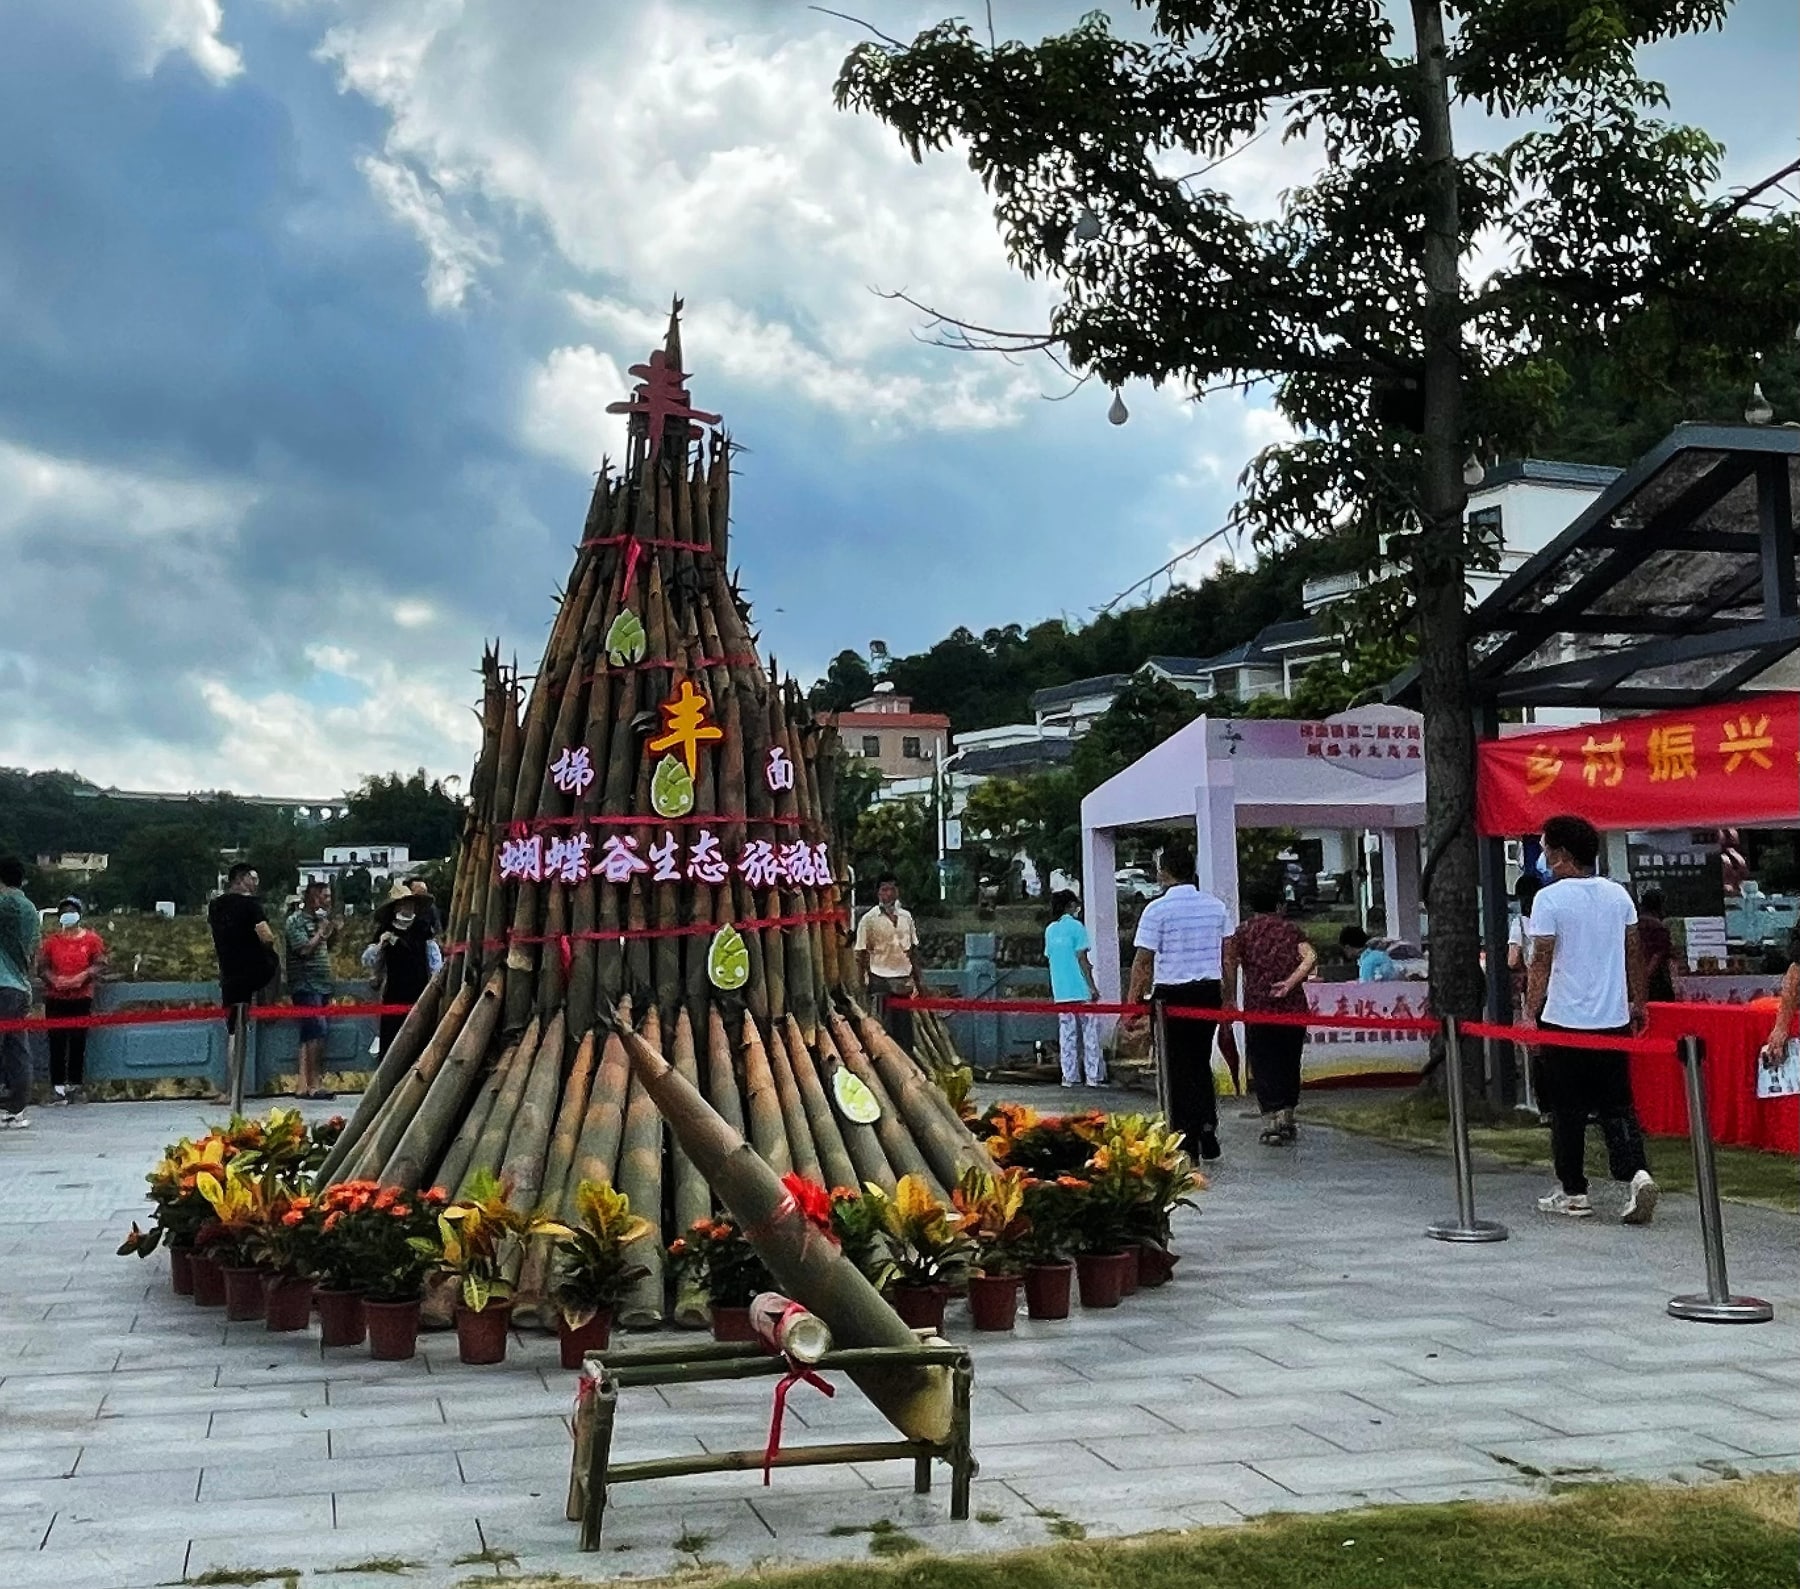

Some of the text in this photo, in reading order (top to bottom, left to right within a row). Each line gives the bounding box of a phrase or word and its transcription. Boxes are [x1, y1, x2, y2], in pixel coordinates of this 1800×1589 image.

[650, 681, 723, 779] 丰
[1525, 713, 1800, 794] 乡村振兴
[550, 746, 795, 796] 梯 面
